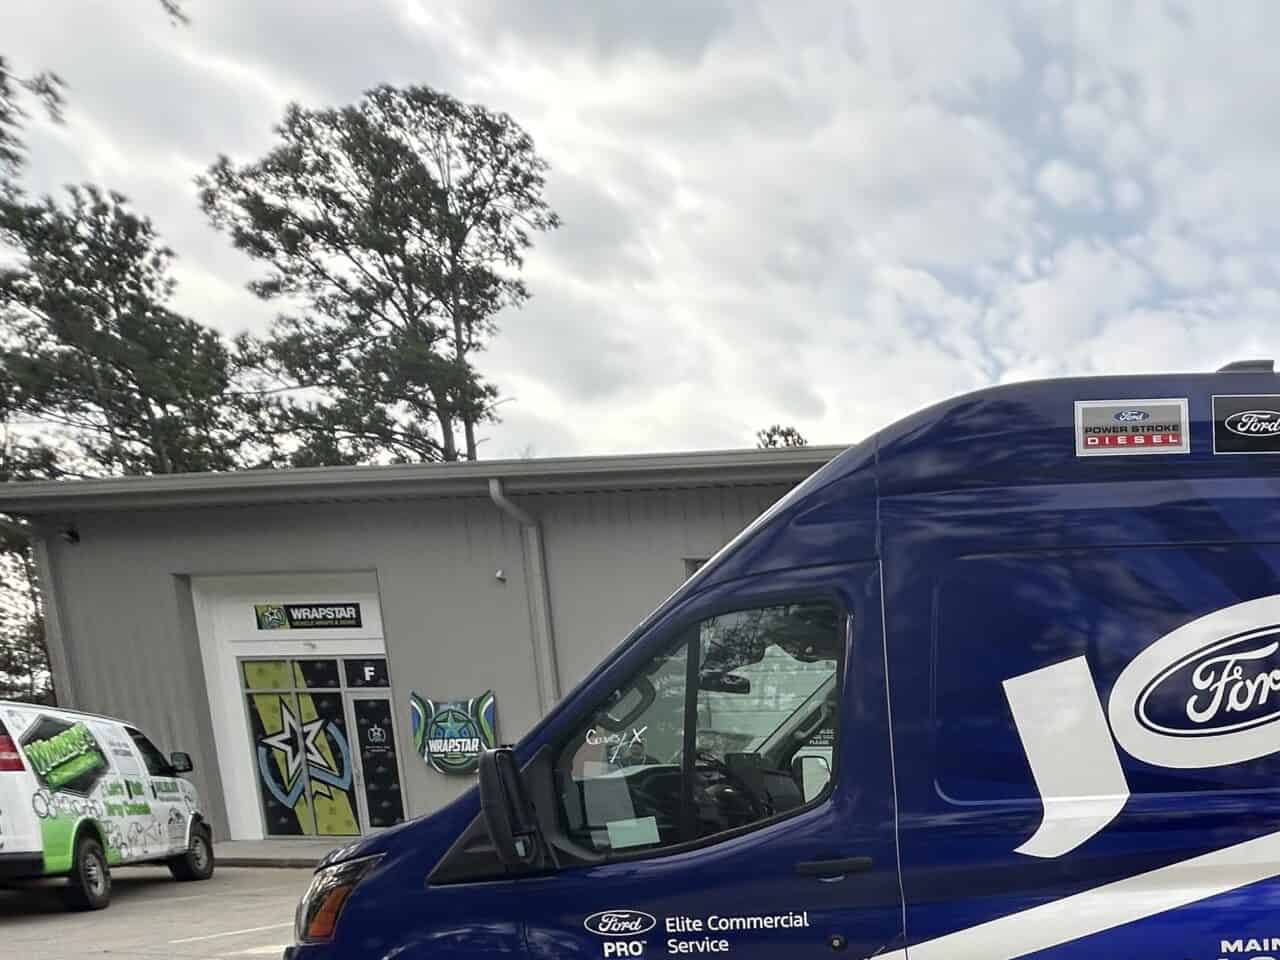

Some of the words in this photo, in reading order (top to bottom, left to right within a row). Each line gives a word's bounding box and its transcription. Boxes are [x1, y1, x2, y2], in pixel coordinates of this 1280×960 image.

[1117, 410, 1147, 422] Ford
[1084, 425, 1125, 434] POWER
[1131, 424, 1180, 433] STROKE
[1087, 434, 1178, 446] DIESEL
[290, 607, 356, 620] WRAPSTAR
[363, 666, 376, 681] F
[428, 738, 480, 753] WRAPSTAR
[598, 913, 642, 932] Ford
[665, 915, 703, 933] Elite
[707, 911, 810, 931] Commercial
[667, 936, 729, 954] Service
